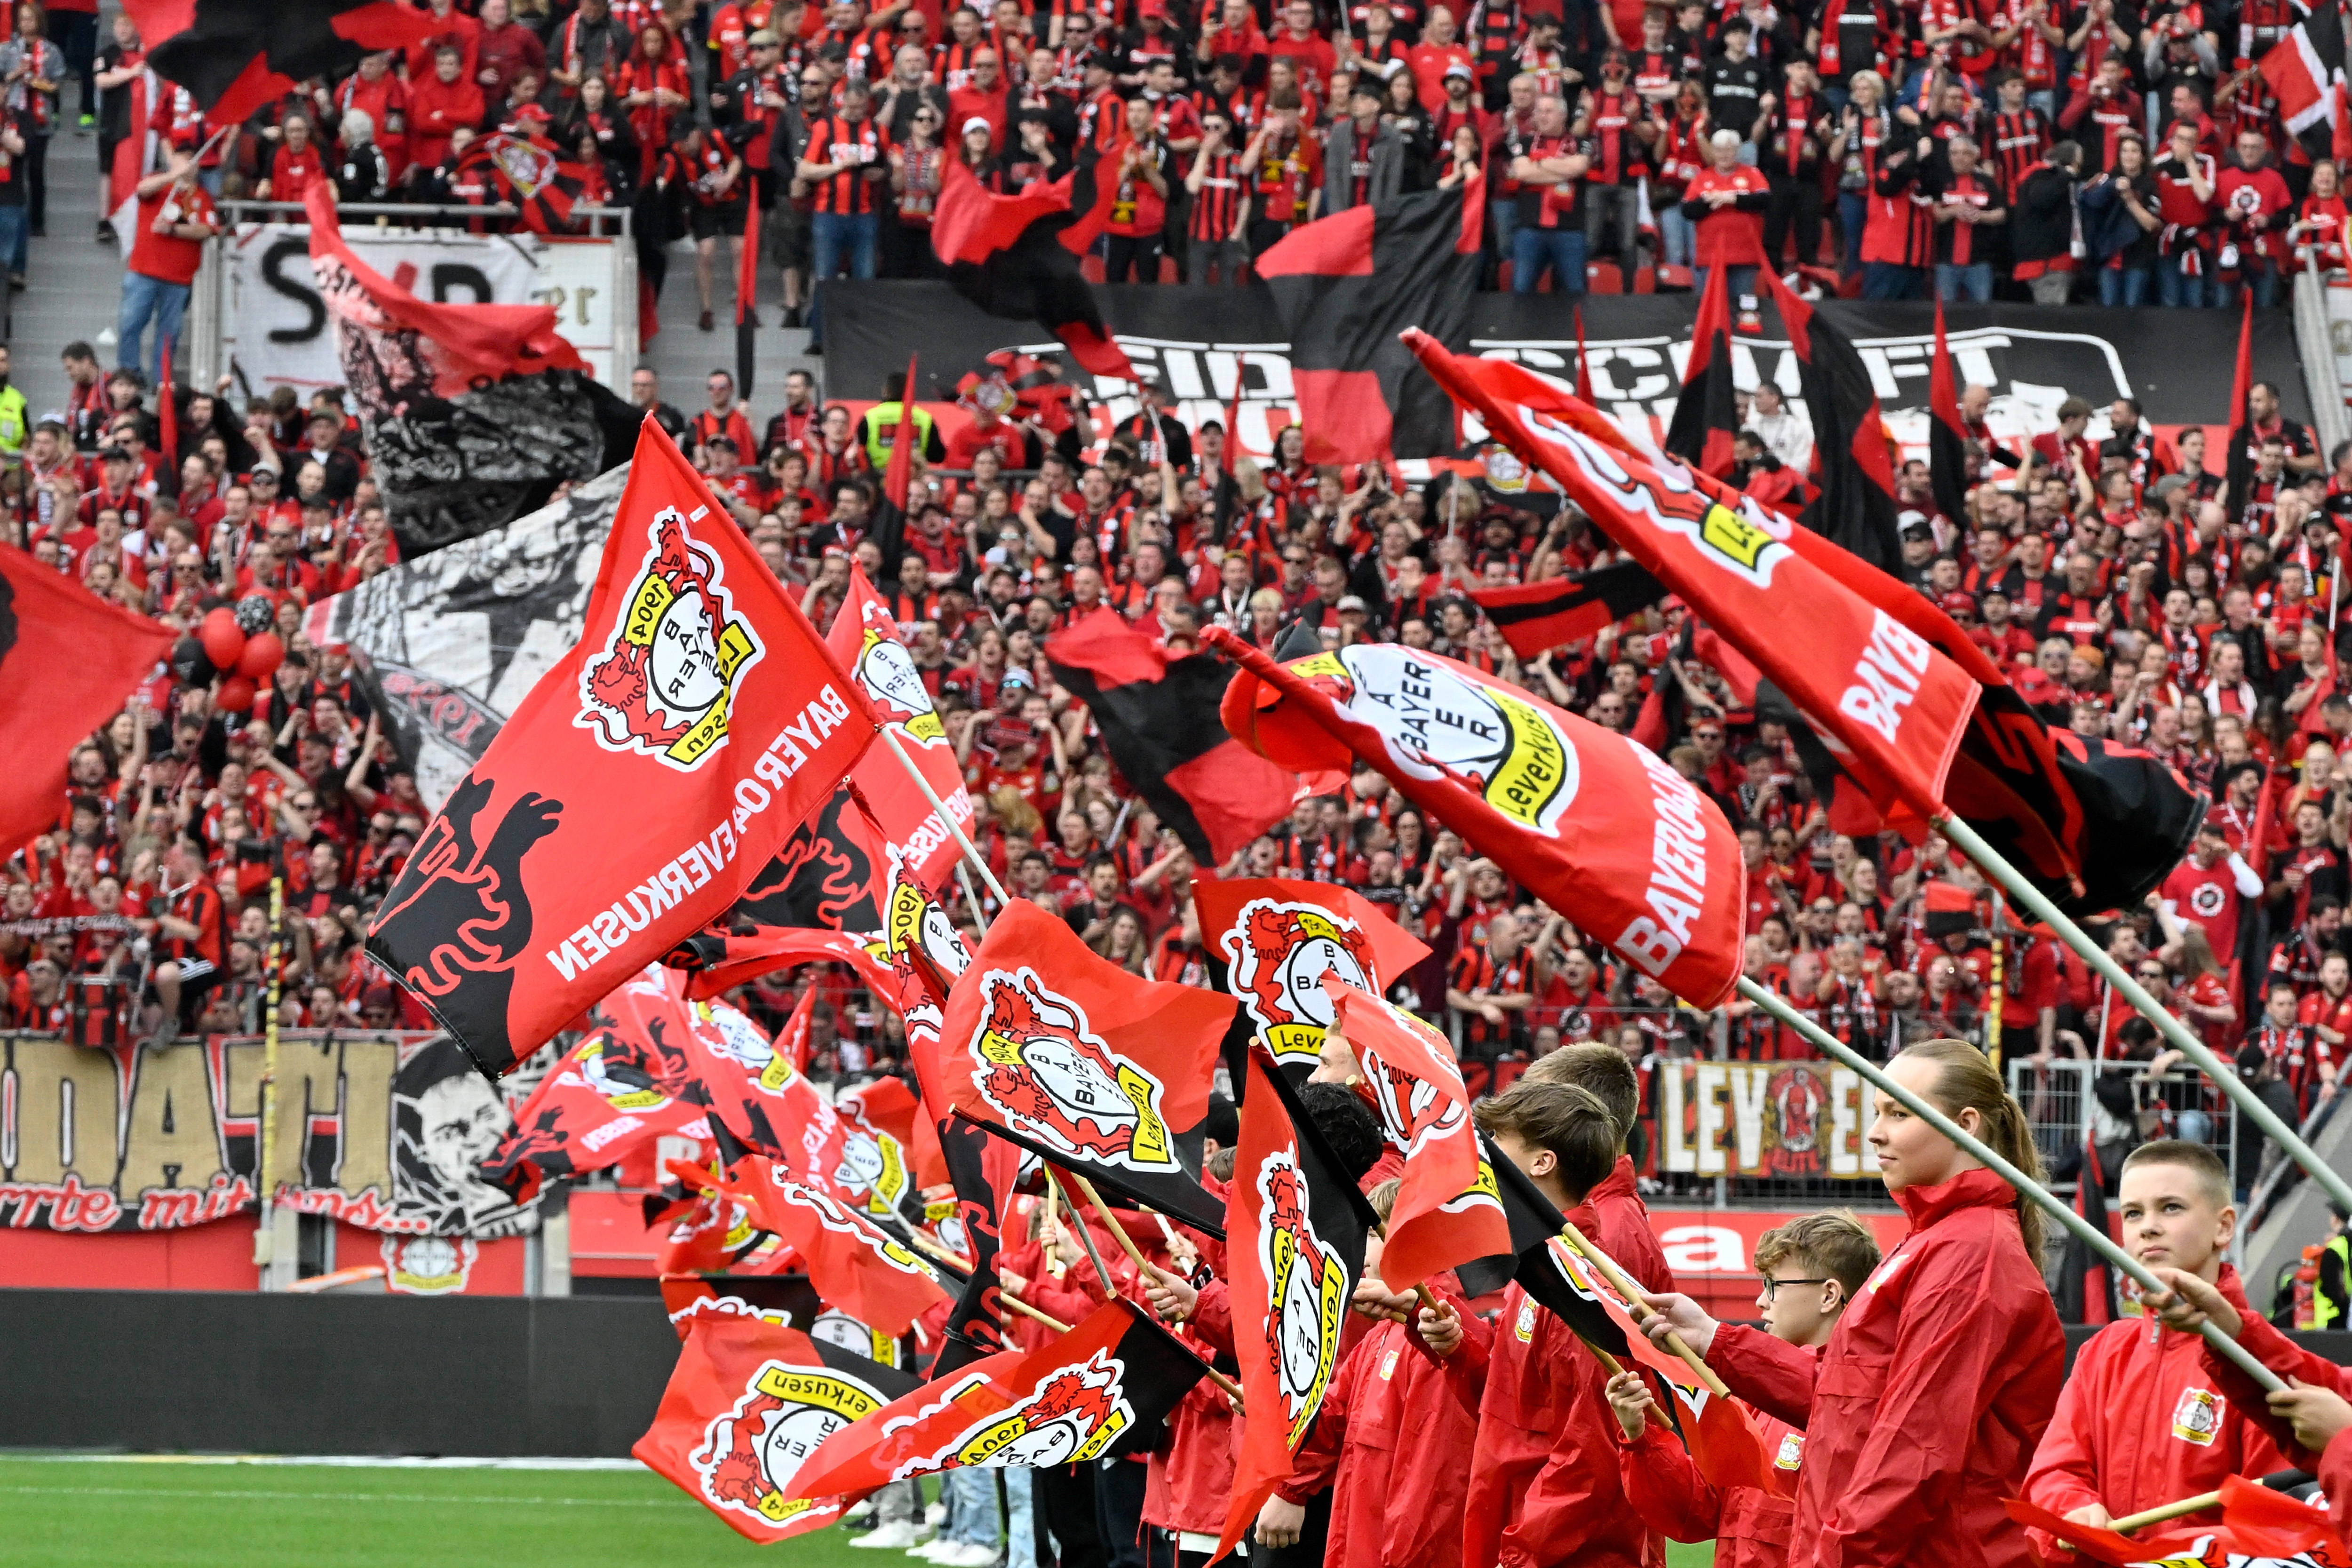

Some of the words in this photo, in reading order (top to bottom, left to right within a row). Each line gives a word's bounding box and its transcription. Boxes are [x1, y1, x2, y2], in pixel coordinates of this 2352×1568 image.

[1400, 662, 1431, 751] BAYER
[1840, 607, 1931, 744] BAYE
[1613, 819, 1706, 977] BAYER
[989, 1040, 1013, 1062] 1904
[1071, 1052, 1095, 1106] BAYER
[0, 1038, 394, 1202] DATI
[1664, 1065, 1769, 1171] LEV
[140, 1173, 256, 1228] mit
[774, 1375, 868, 1412] erkusen
